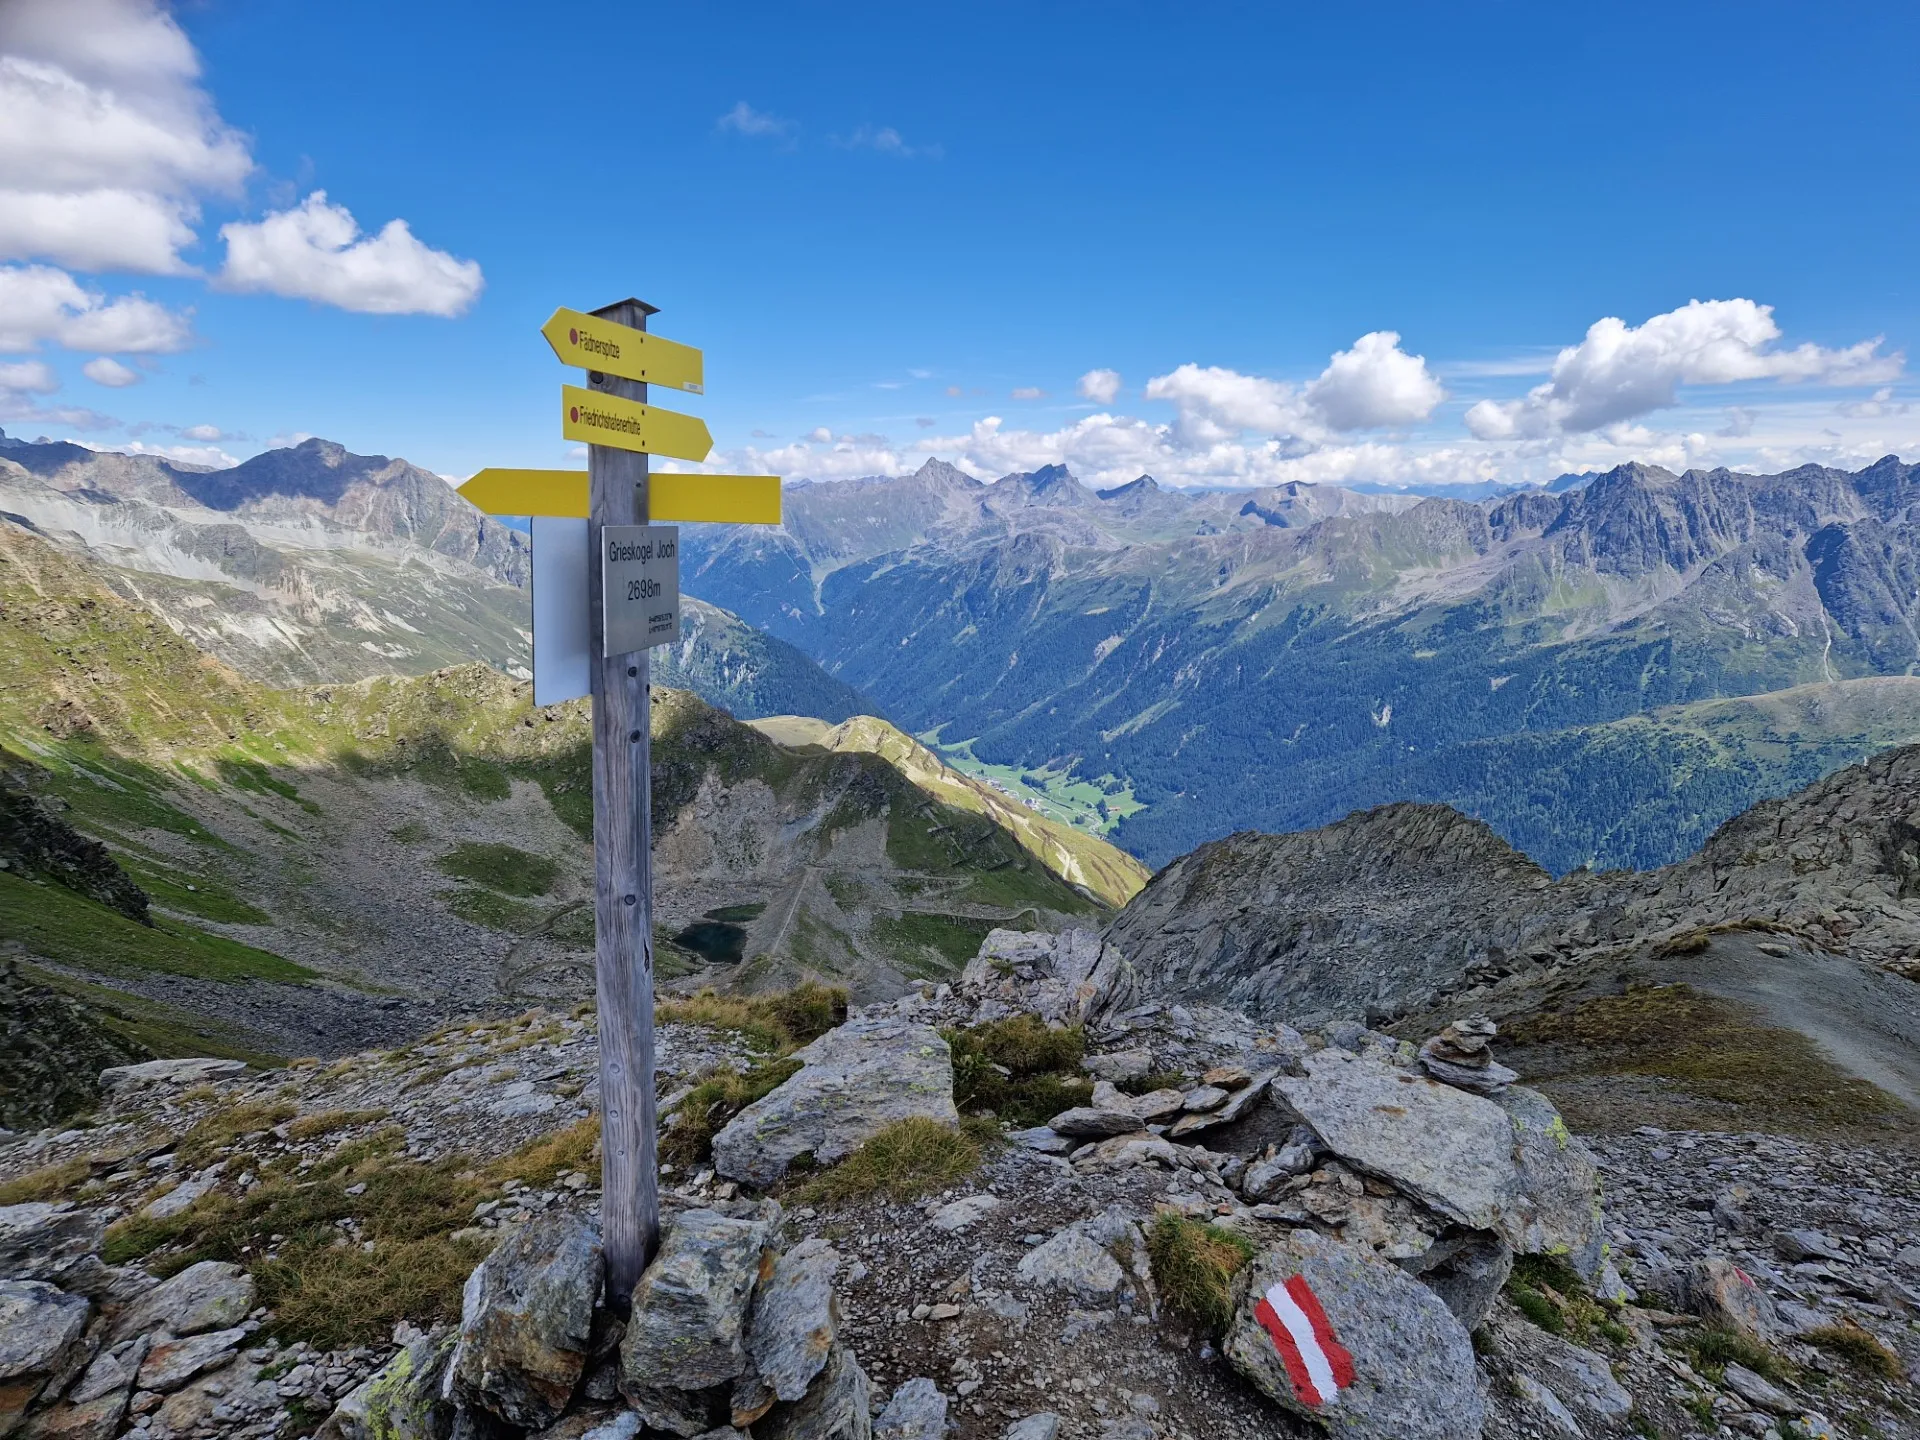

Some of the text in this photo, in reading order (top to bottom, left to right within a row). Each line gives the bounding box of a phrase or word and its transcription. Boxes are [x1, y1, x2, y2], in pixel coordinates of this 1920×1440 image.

[579, 330, 620, 361] Fädnerspitze
[609, 538, 675, 565] Grieskogel Joch
[627, 578, 661, 601] 2698m
